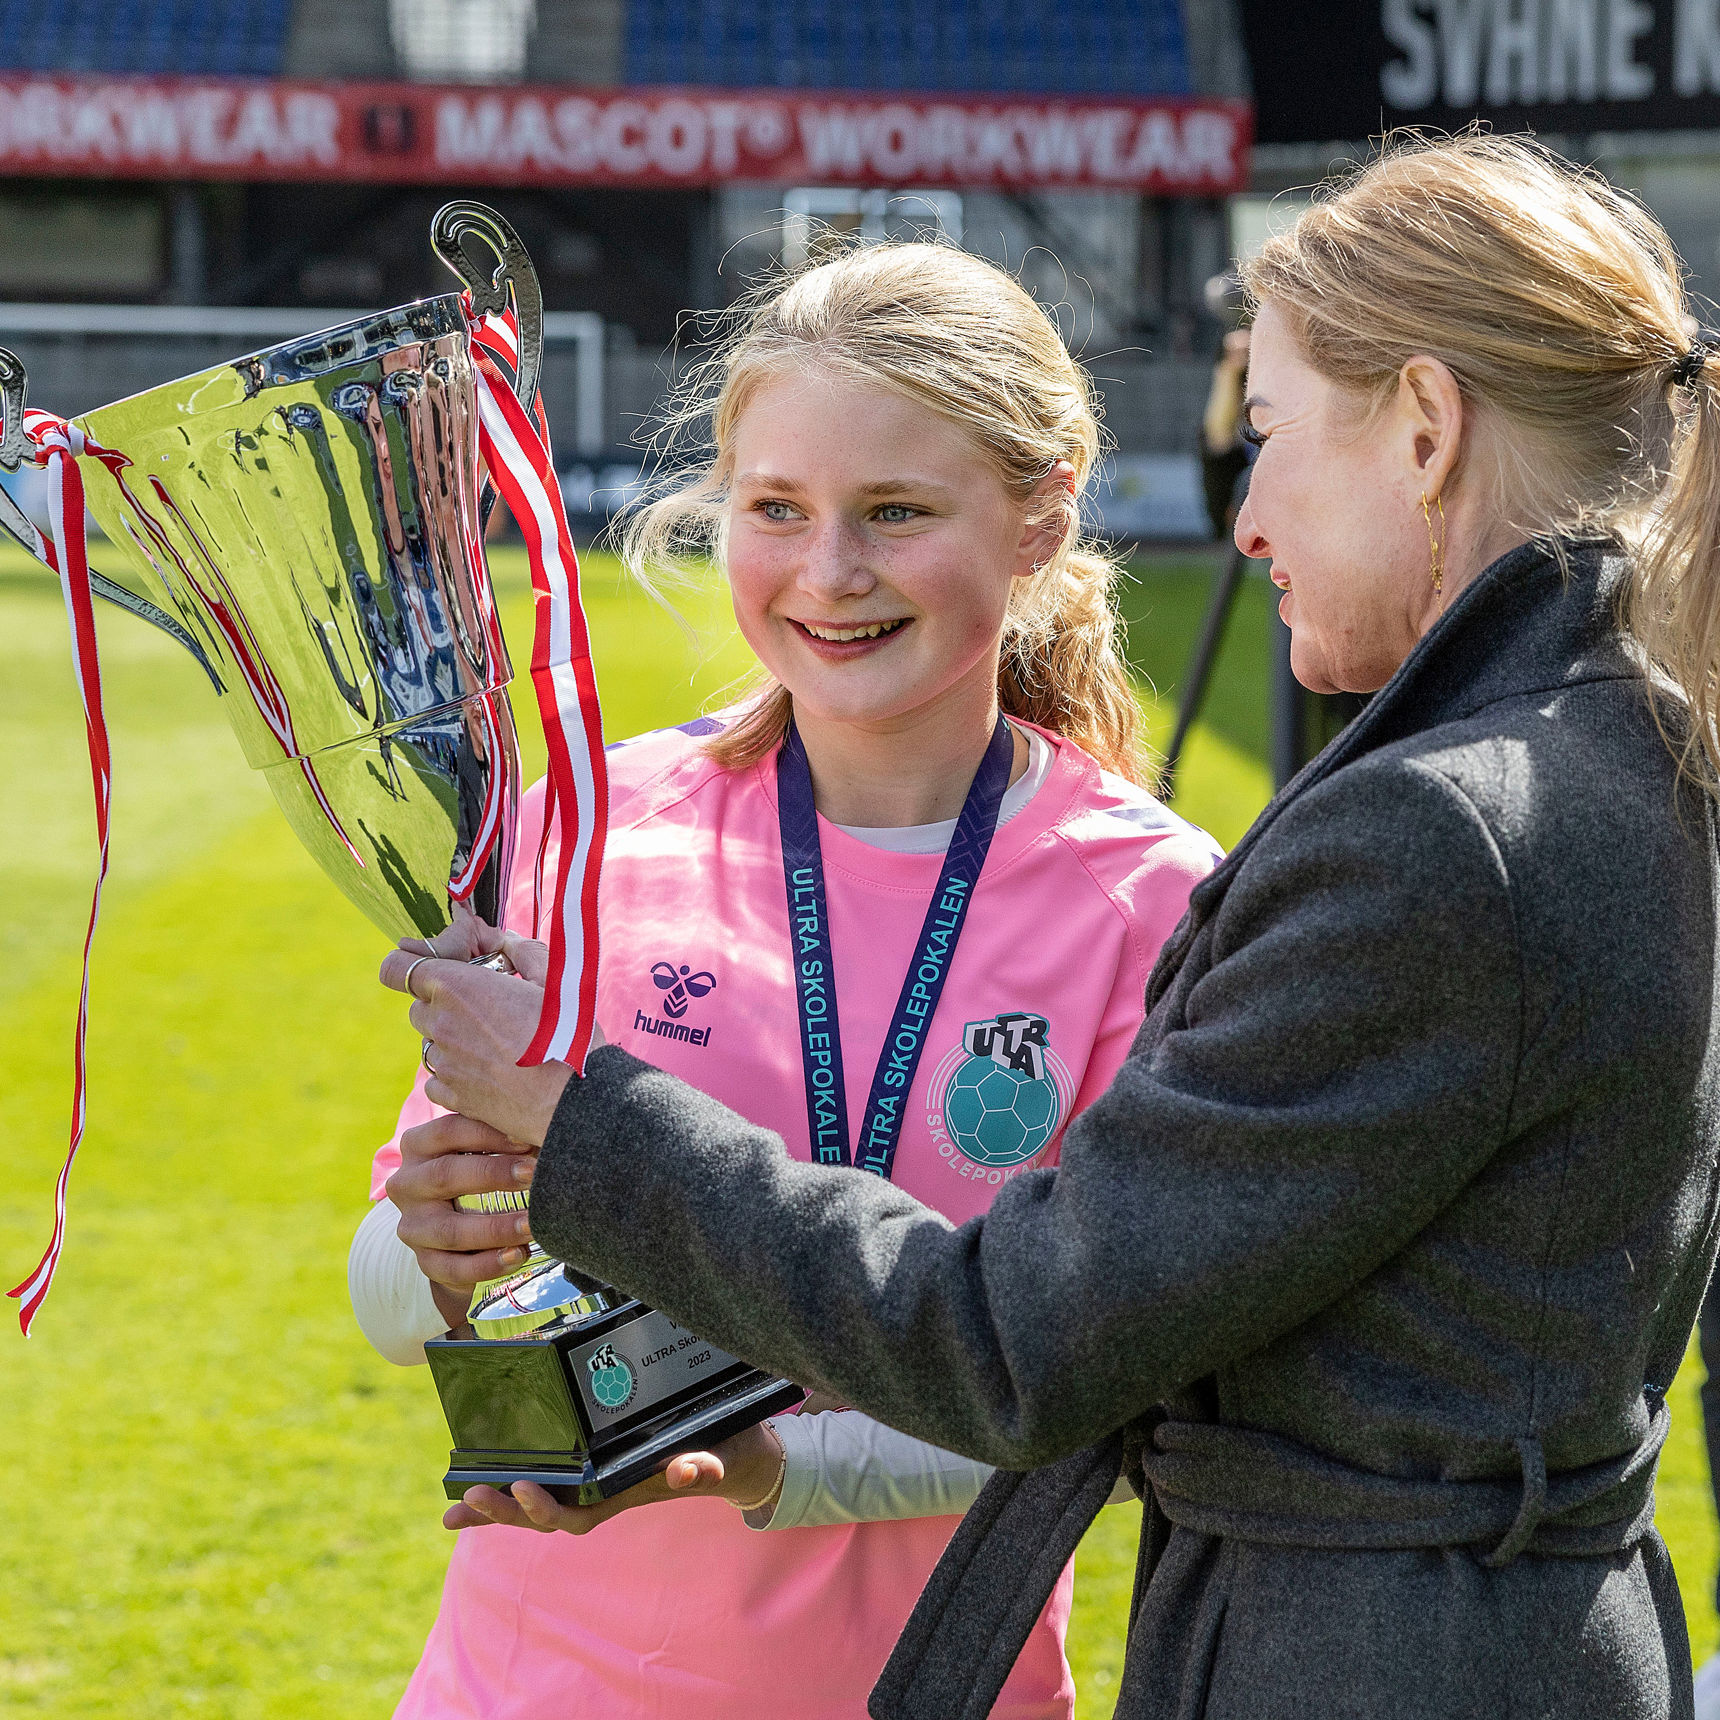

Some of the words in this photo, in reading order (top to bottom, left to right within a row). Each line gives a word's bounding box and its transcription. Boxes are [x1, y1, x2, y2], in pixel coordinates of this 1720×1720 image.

[803, 104, 1236, 184] WORKWEAR
[792, 868, 820, 954] ULTRA
[884, 877, 969, 1088] SKOLEPOKALEN
[634, 1009, 712, 1047] hummel
[801, 960, 841, 1166] SKOLEPOKALE
[641, 1344, 677, 1367] ULTRA
[687, 1350, 712, 1369] 2023
[591, 1378, 638, 1414] SKOLEPOKALEN
